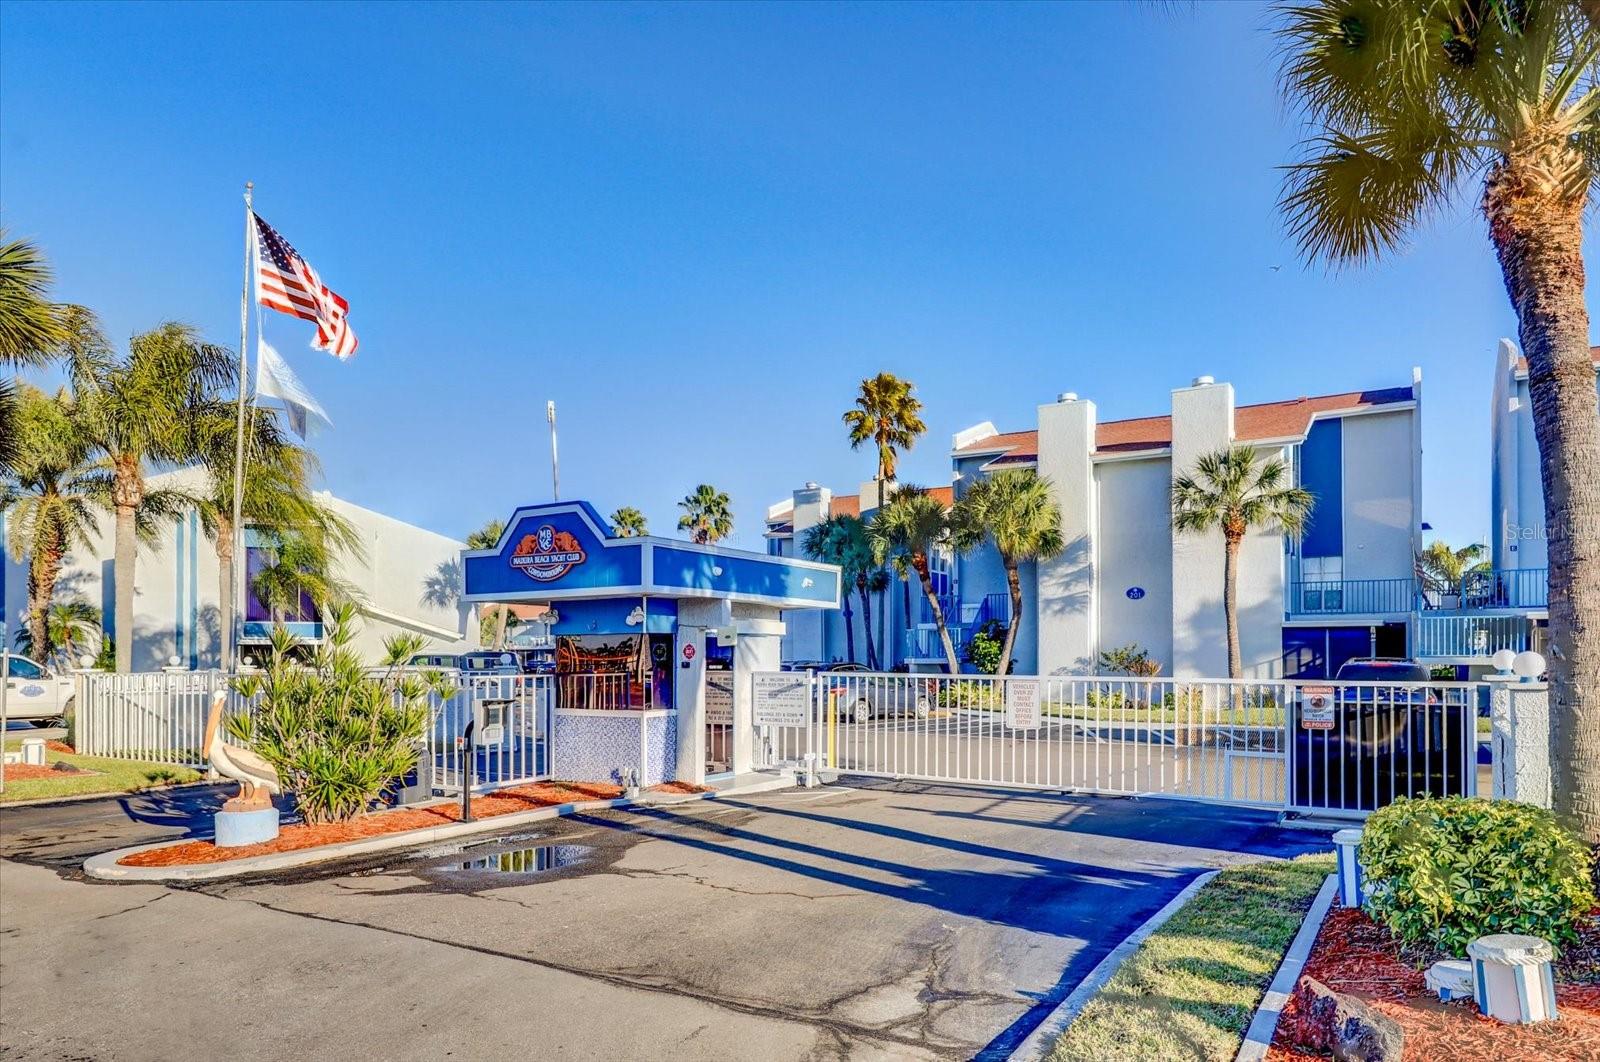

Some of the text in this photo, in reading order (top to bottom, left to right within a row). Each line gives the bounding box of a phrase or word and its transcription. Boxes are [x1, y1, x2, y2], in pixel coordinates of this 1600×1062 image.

[513, 552, 580, 565] MADEIRA BEACH YACHT CLUB
